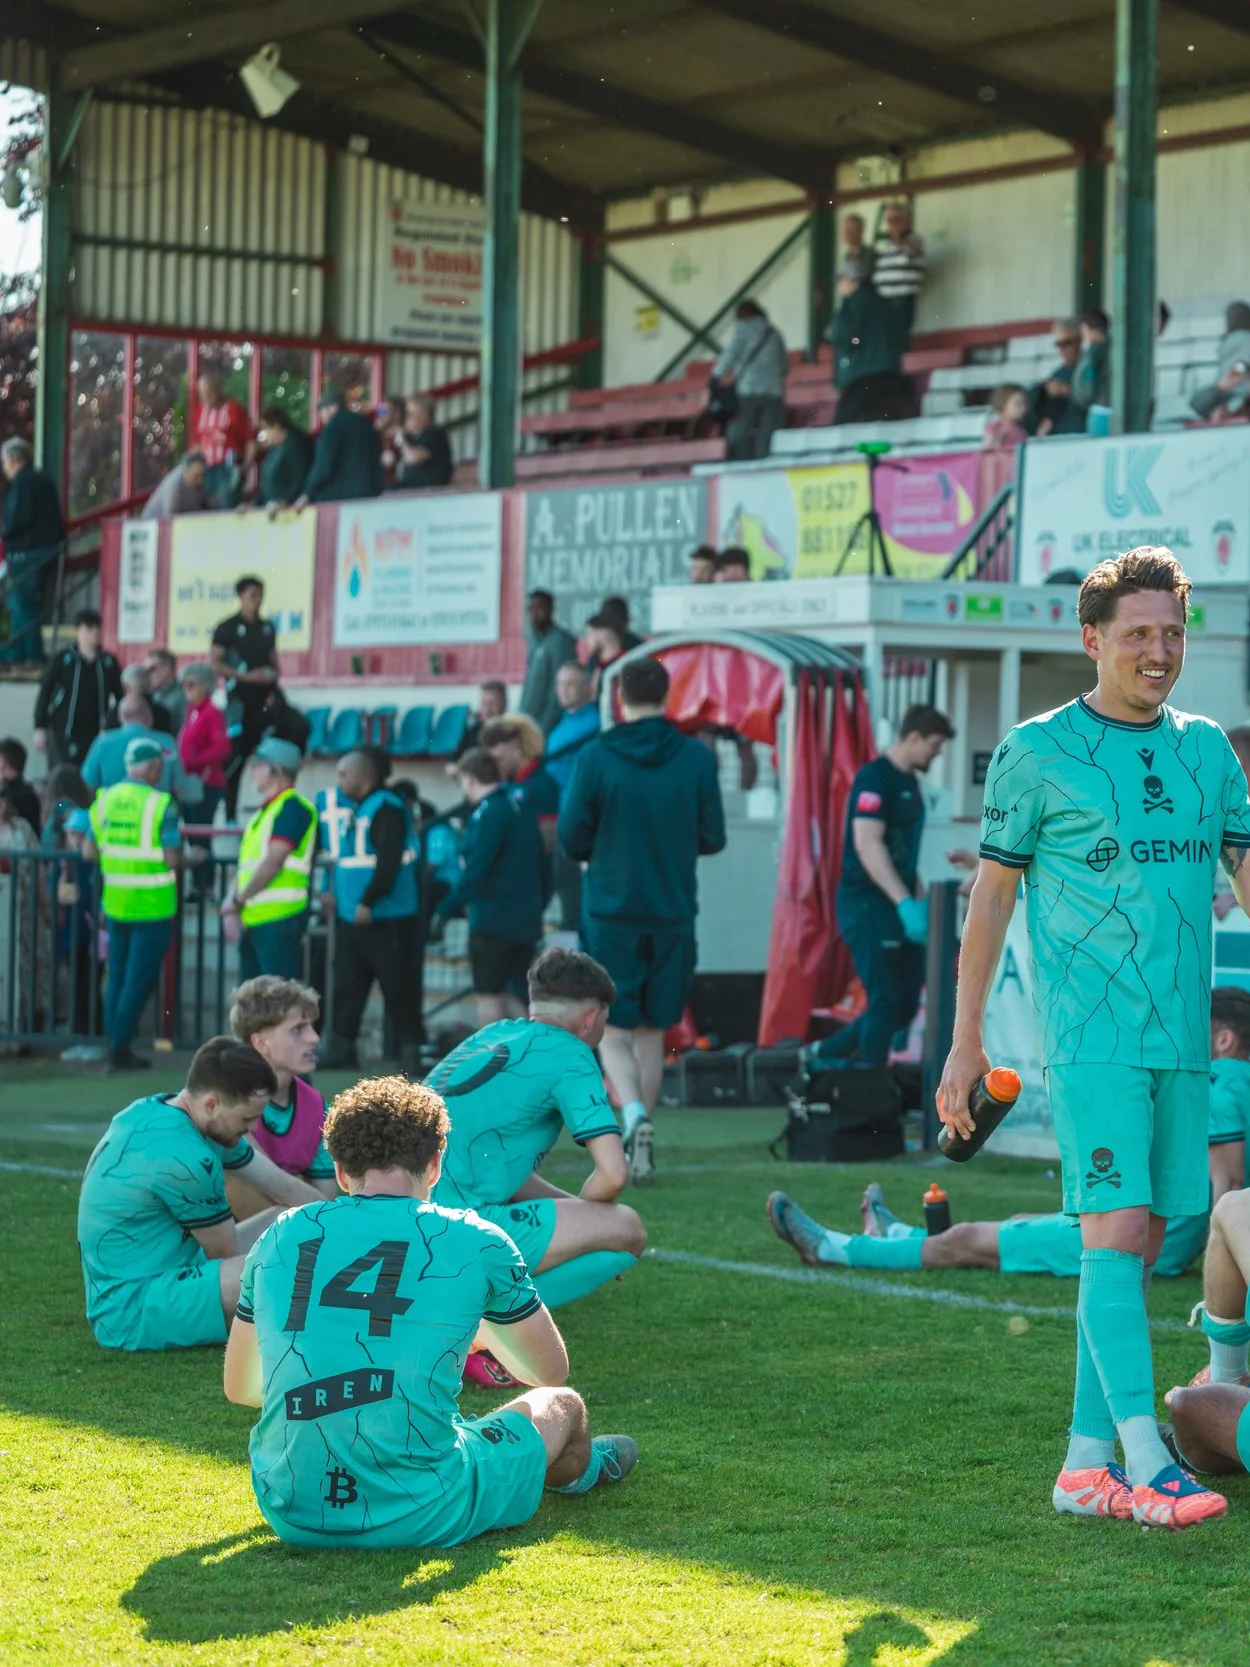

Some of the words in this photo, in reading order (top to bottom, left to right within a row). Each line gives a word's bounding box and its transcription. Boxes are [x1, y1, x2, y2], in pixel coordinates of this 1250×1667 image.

[575, 485, 699, 545] PULLEN
[1099, 526, 1192, 549] ELECTRICAL
[1131, 840, 1212, 863] GEMIN
[282, 1236, 415, 1338] 14
[291, 1373, 384, 1416] IREN
